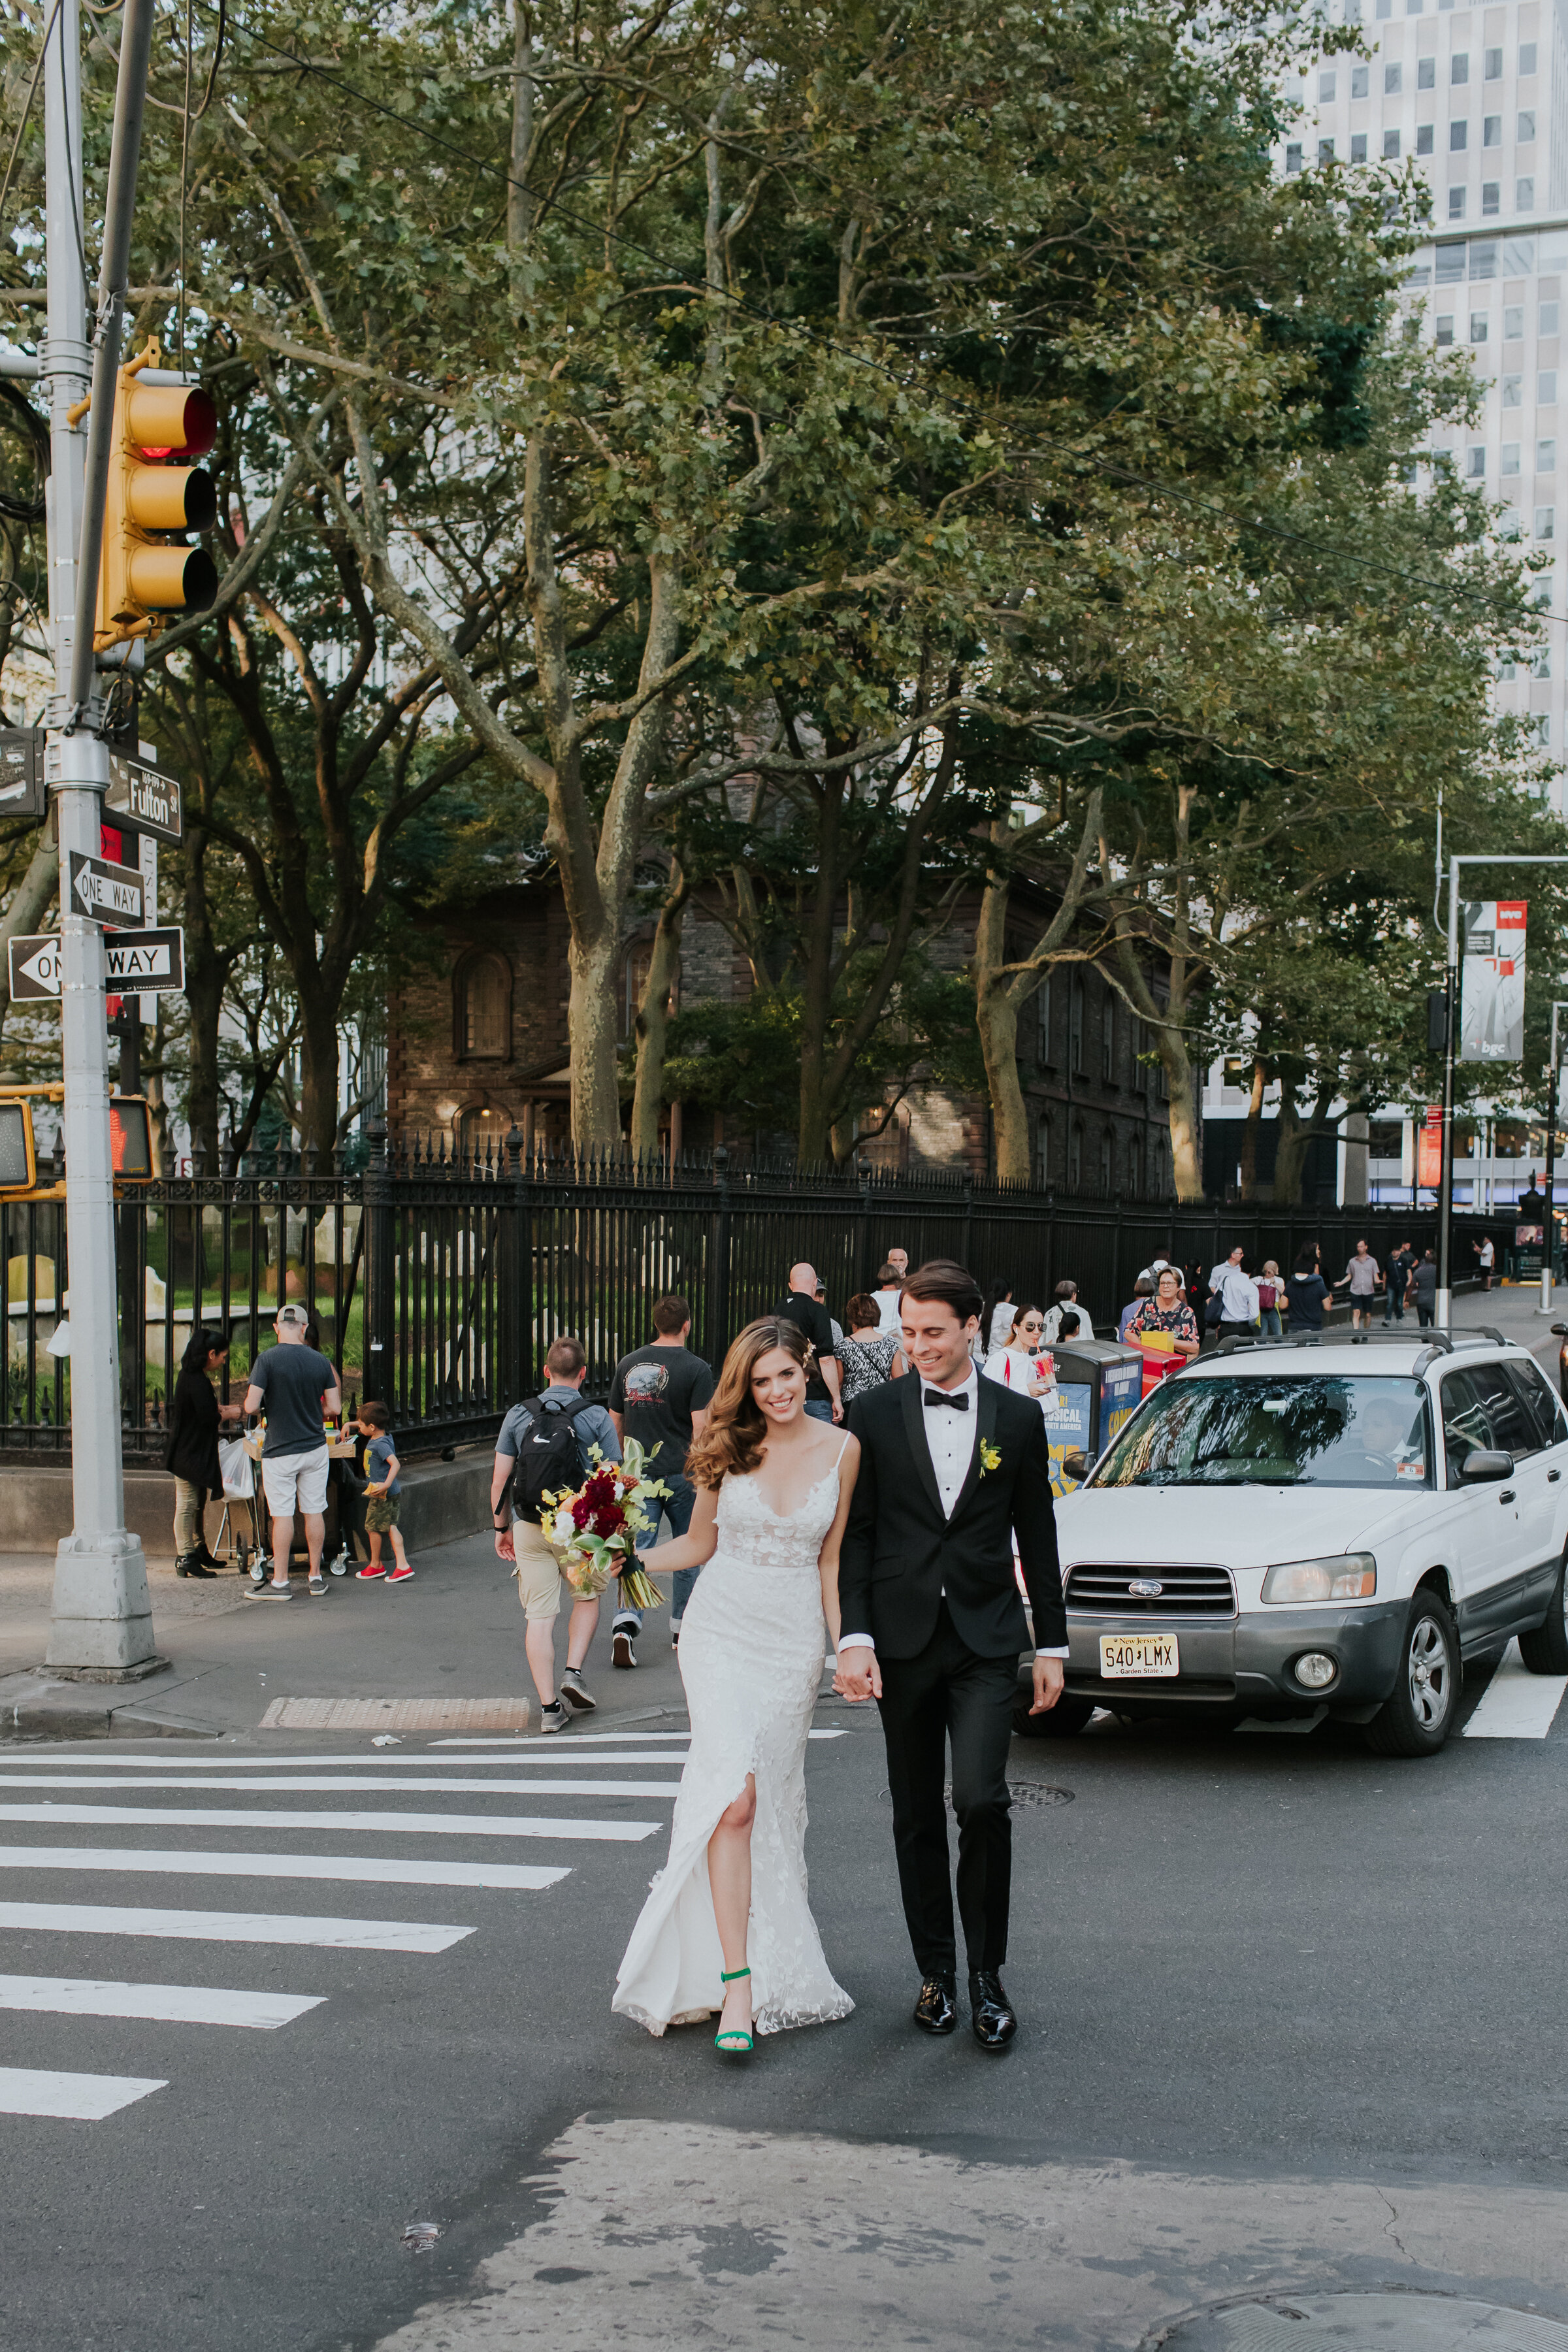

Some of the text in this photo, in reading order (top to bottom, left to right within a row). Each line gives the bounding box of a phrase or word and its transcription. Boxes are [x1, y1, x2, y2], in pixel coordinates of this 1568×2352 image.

[131, 777, 178, 825] Fulton St
[82, 875, 135, 912] ONE WAY
[38, 949, 158, 978] ON WAY
[1481, 1040, 1505, 1056] bgc
[1105, 1645, 1172, 1667] S40 LMX
